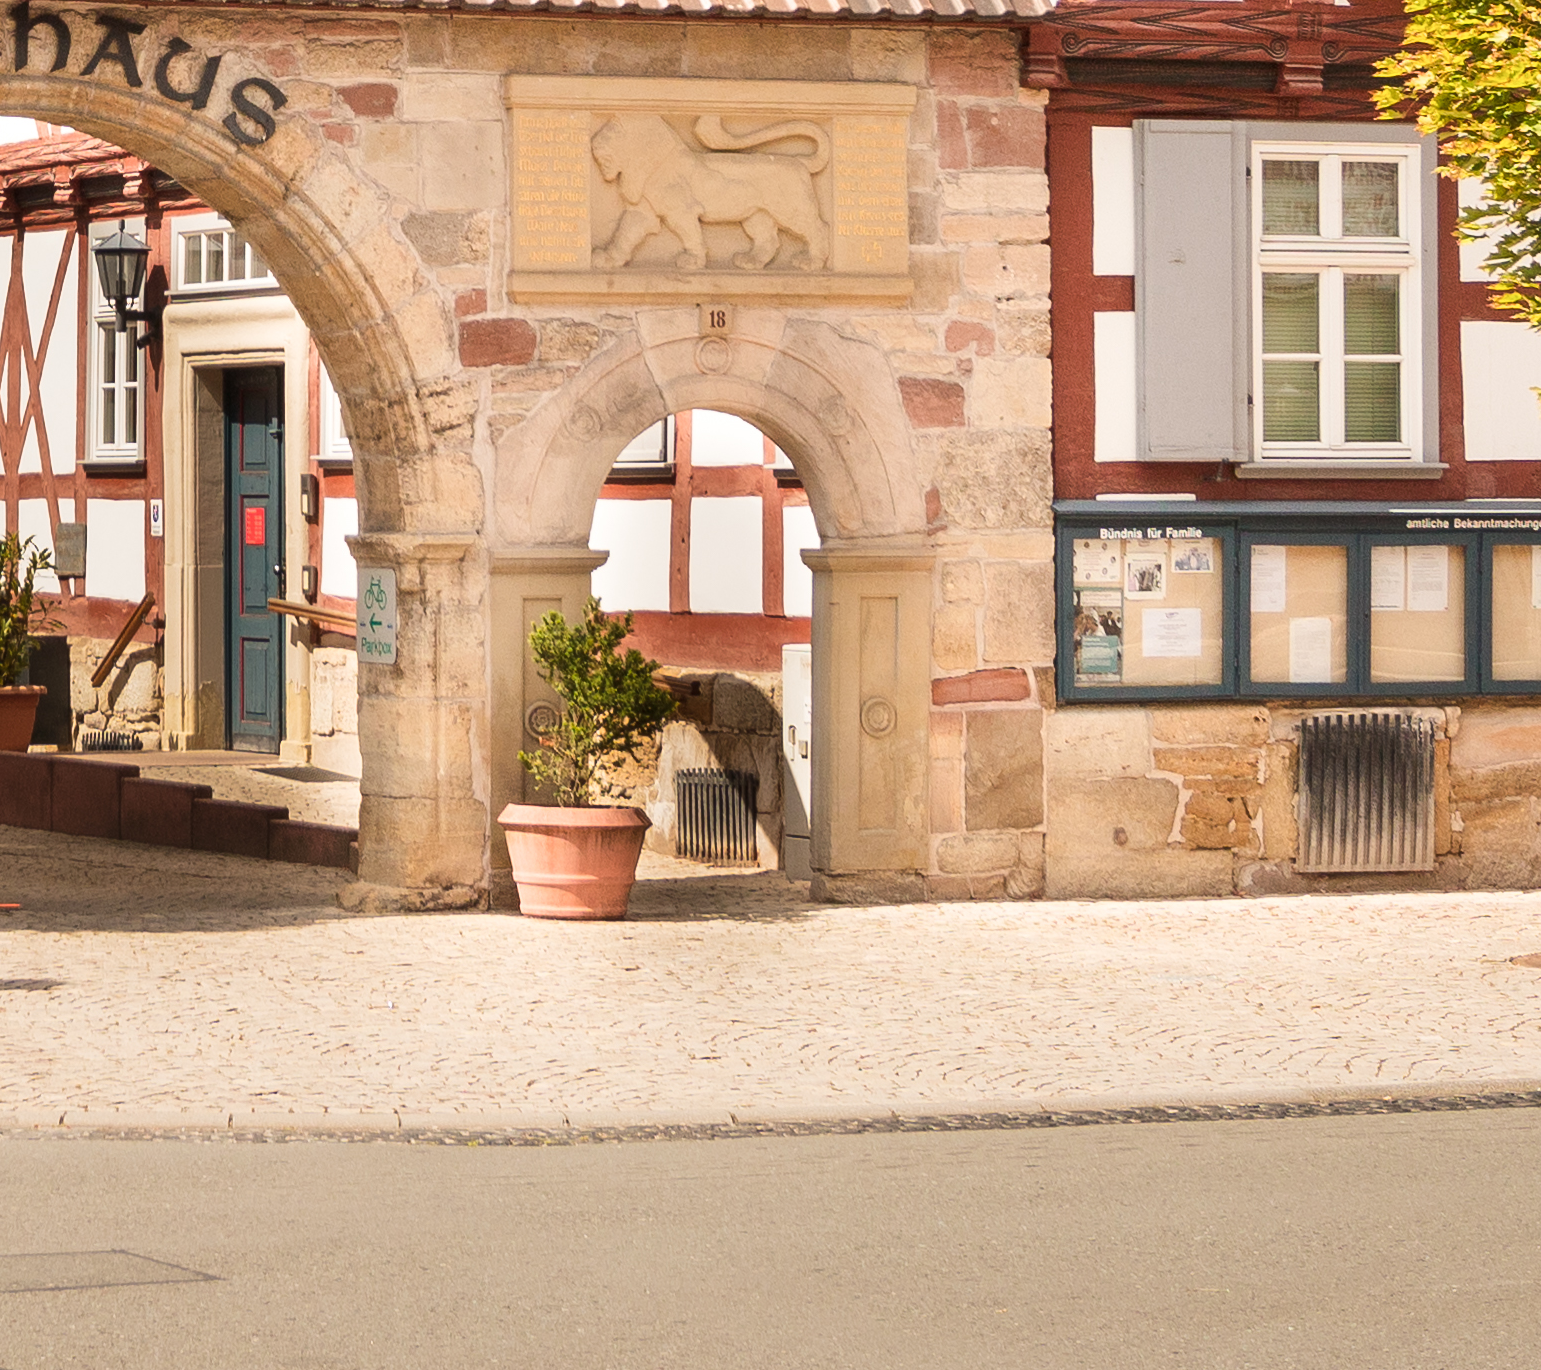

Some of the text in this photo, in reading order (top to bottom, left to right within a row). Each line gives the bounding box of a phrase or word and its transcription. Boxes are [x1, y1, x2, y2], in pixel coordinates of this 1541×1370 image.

[709, 310, 726, 328] 18
[1406, 518, 1449, 529] amtliche
[1099, 526, 1203, 540] Bündnis für Familie
